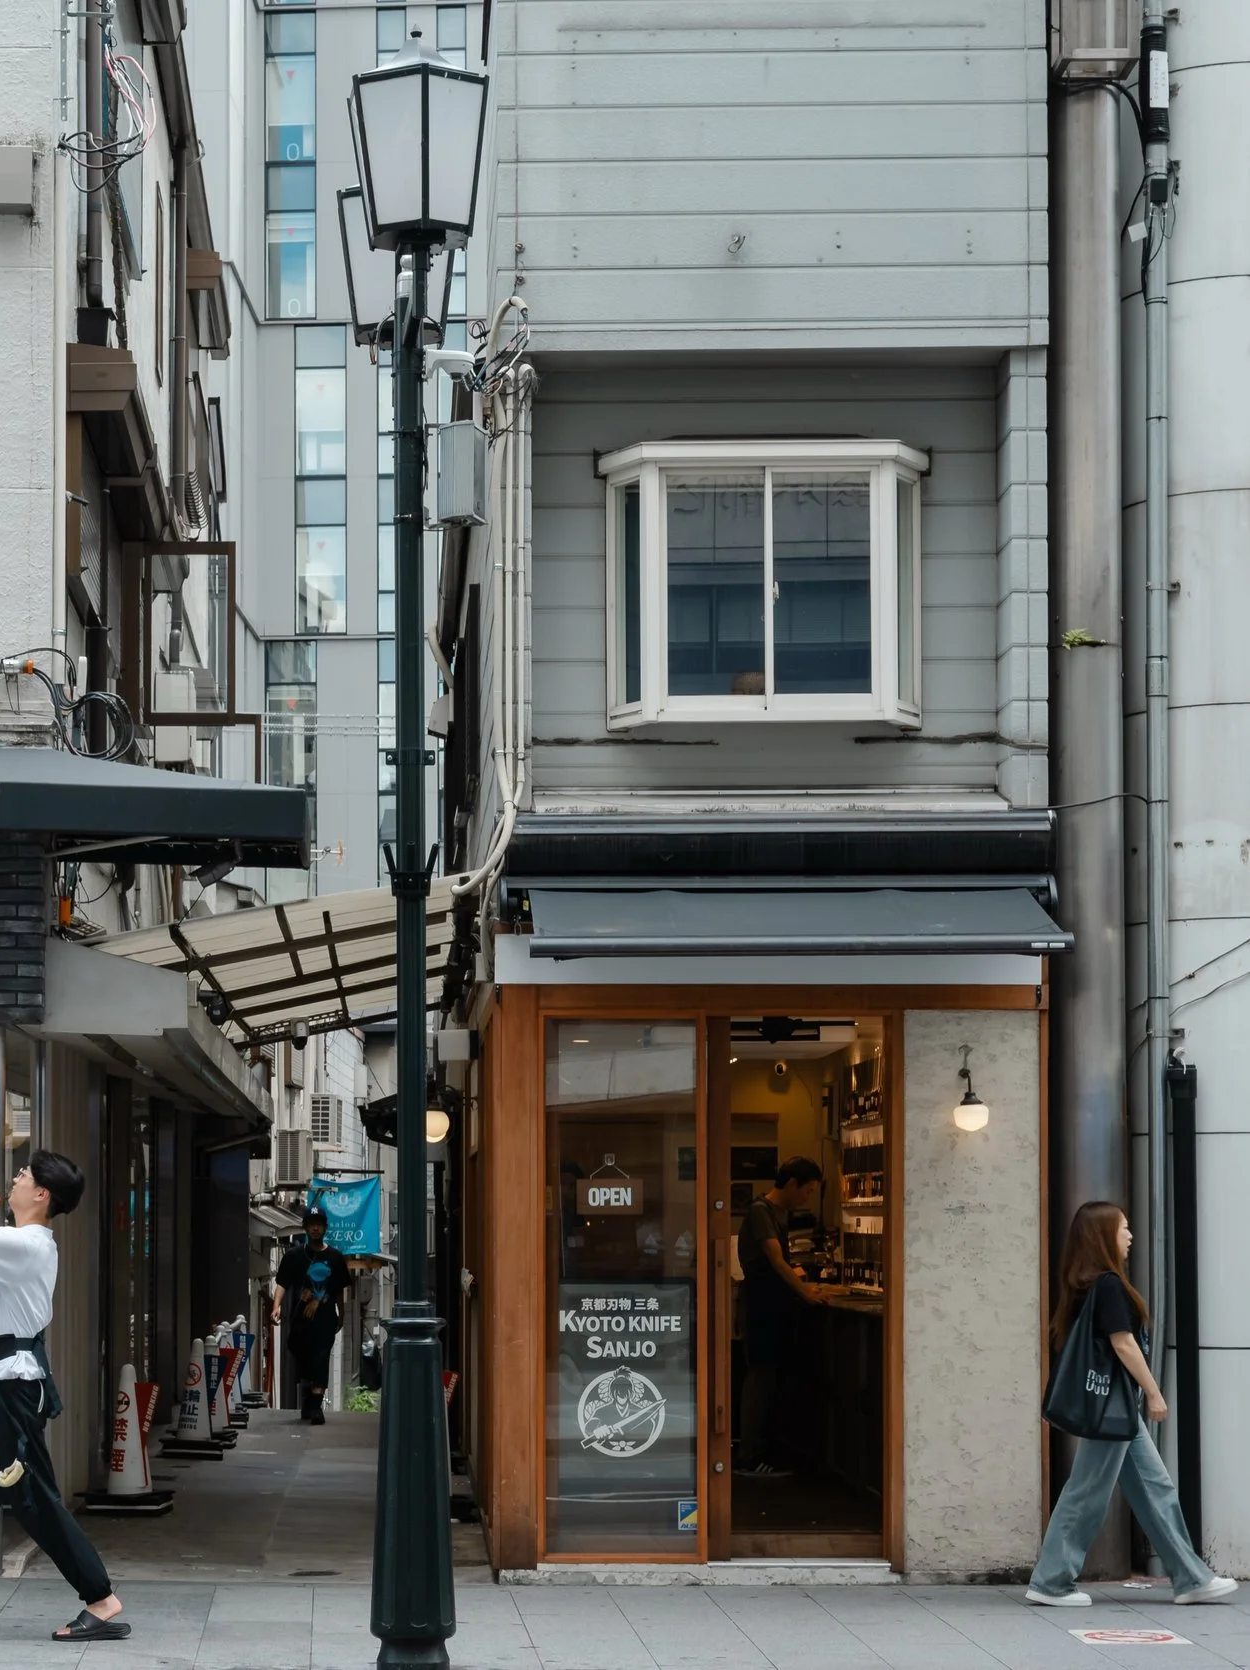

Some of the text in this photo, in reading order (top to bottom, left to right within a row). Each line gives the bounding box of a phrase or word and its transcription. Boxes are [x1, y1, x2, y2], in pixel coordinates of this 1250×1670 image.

[588, 1187, 632, 1207] OPEN
[330, 1220, 356, 1228] salon
[323, 1229, 364, 1242] ZERO
[581, 1298, 659, 1311] 京都刃物 三条
[628, 1316, 681, 1332] KNIFE
[142, 1385, 159, 1433] NO SMOKING
